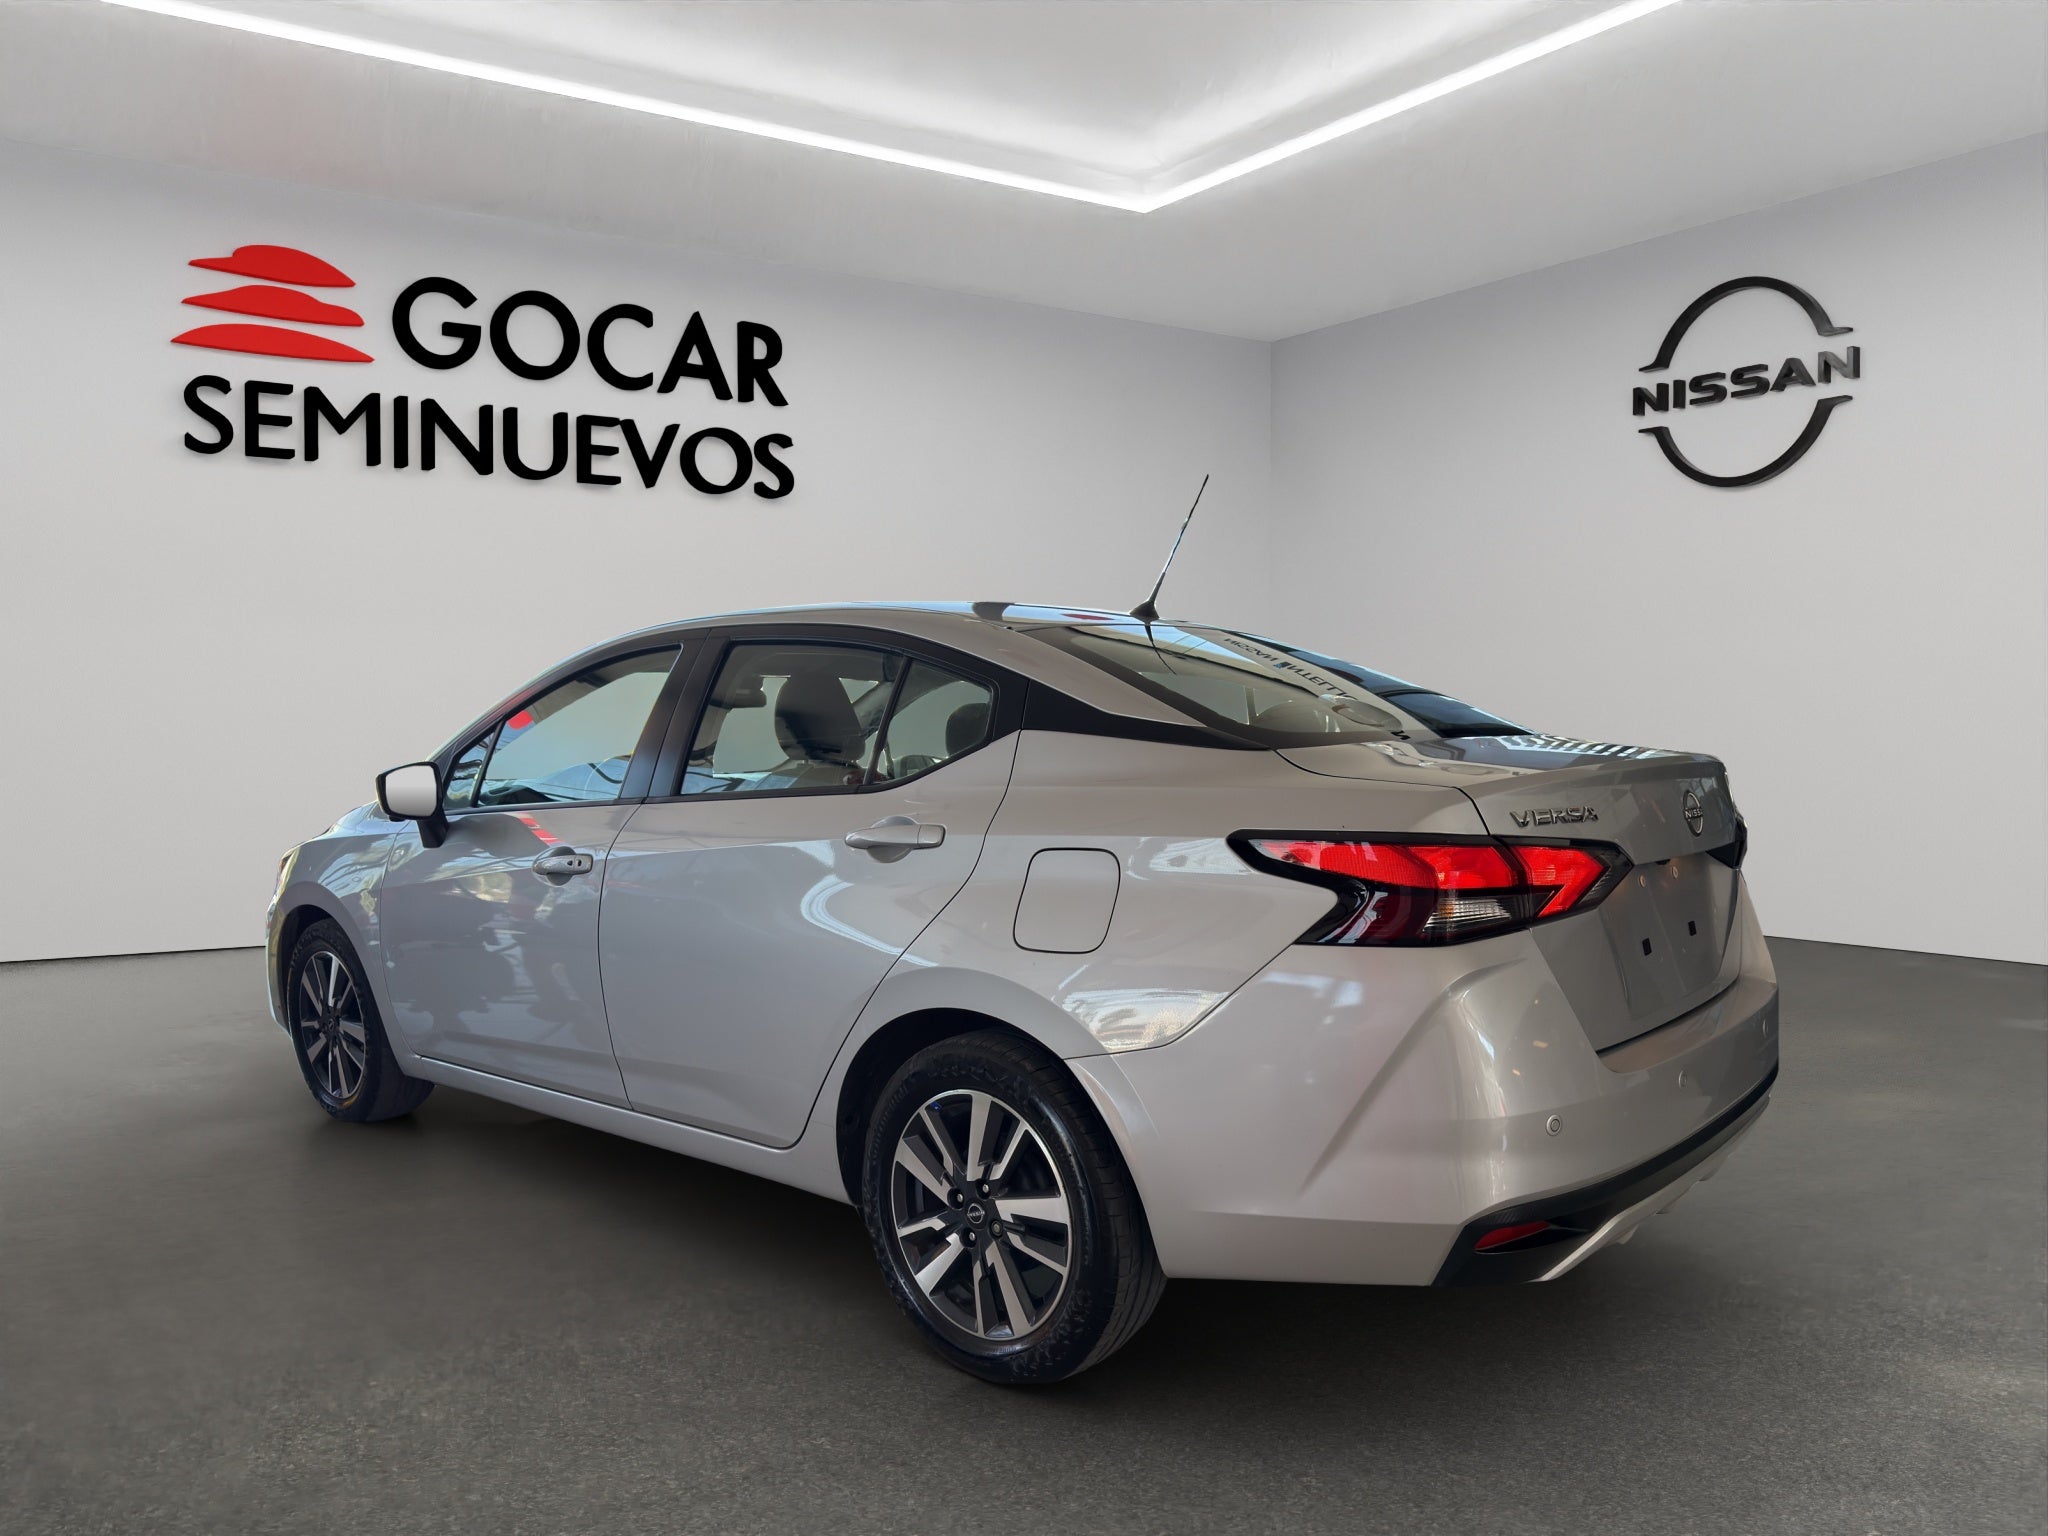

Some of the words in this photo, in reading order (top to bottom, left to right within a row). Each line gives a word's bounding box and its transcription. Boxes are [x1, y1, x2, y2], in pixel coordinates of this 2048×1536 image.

[392, 276, 789, 407] GOCAR
[1632, 345, 1860, 416] NISSAN
[183, 374, 795, 499] SEMINUEVOS
[1509, 806, 1599, 828] VERSA
